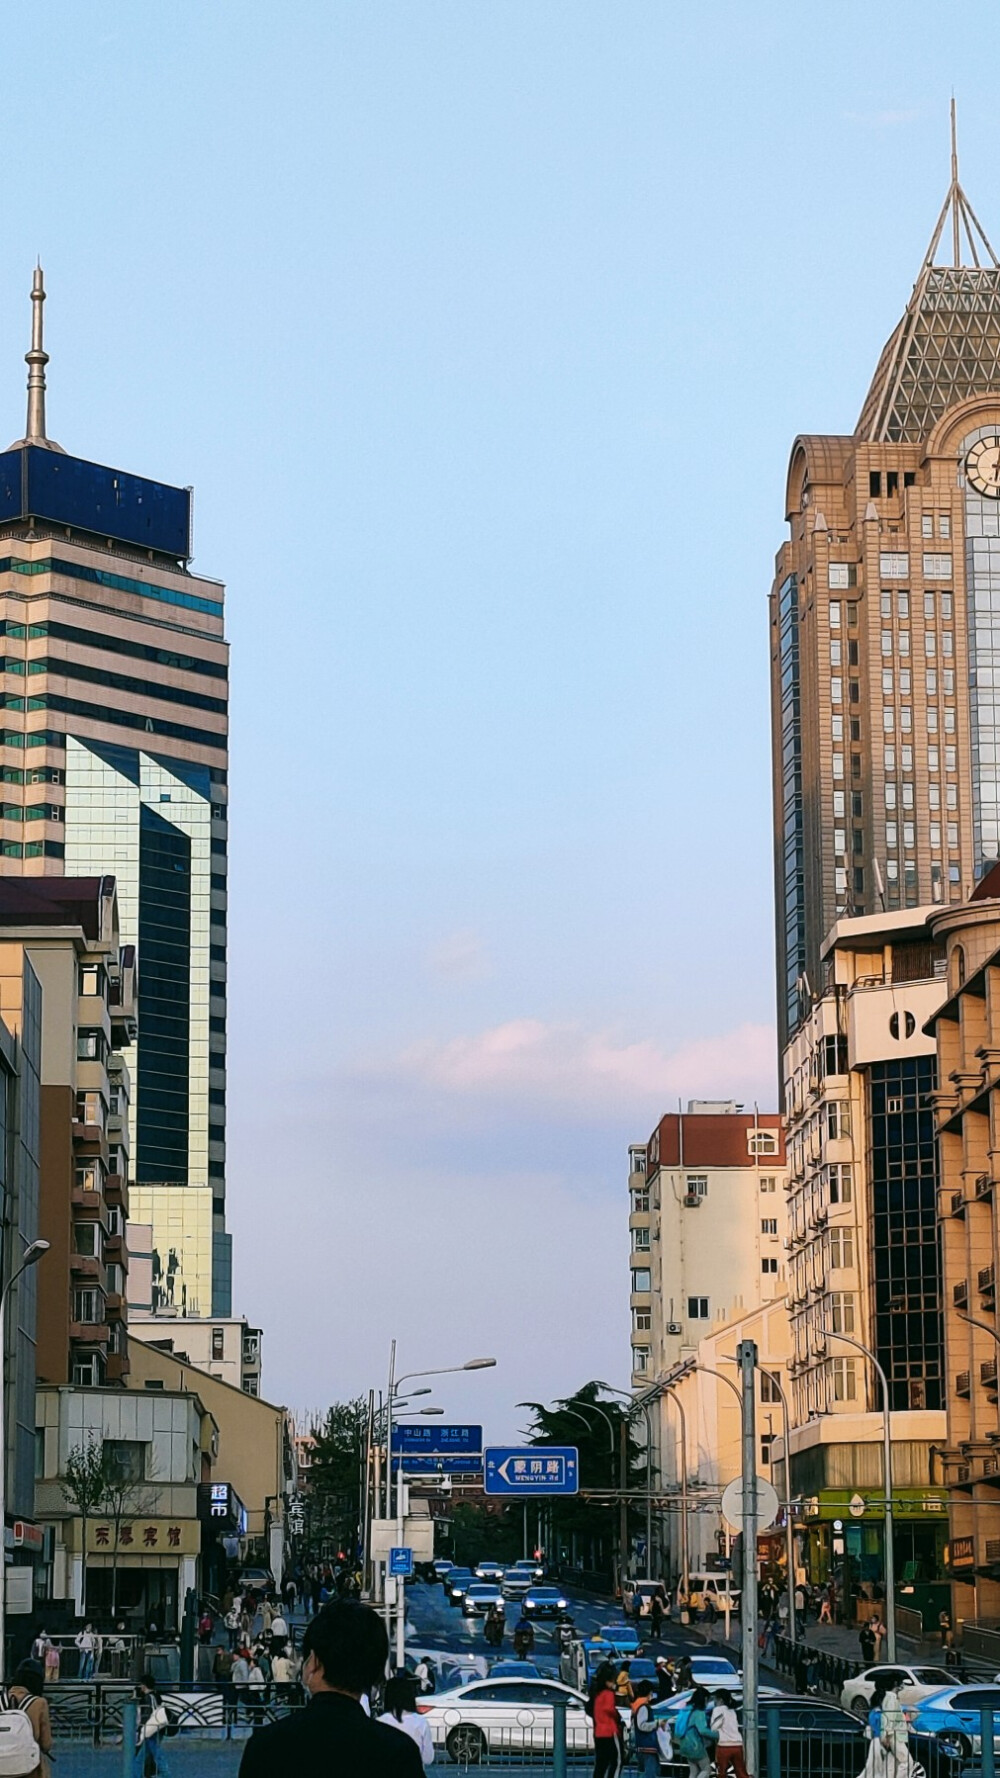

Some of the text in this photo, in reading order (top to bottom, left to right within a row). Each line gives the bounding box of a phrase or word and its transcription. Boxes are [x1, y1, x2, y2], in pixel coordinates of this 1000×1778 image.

[513, 1460, 559, 1474] 蒙阴路
[210, 1484, 228, 1517] 超市
